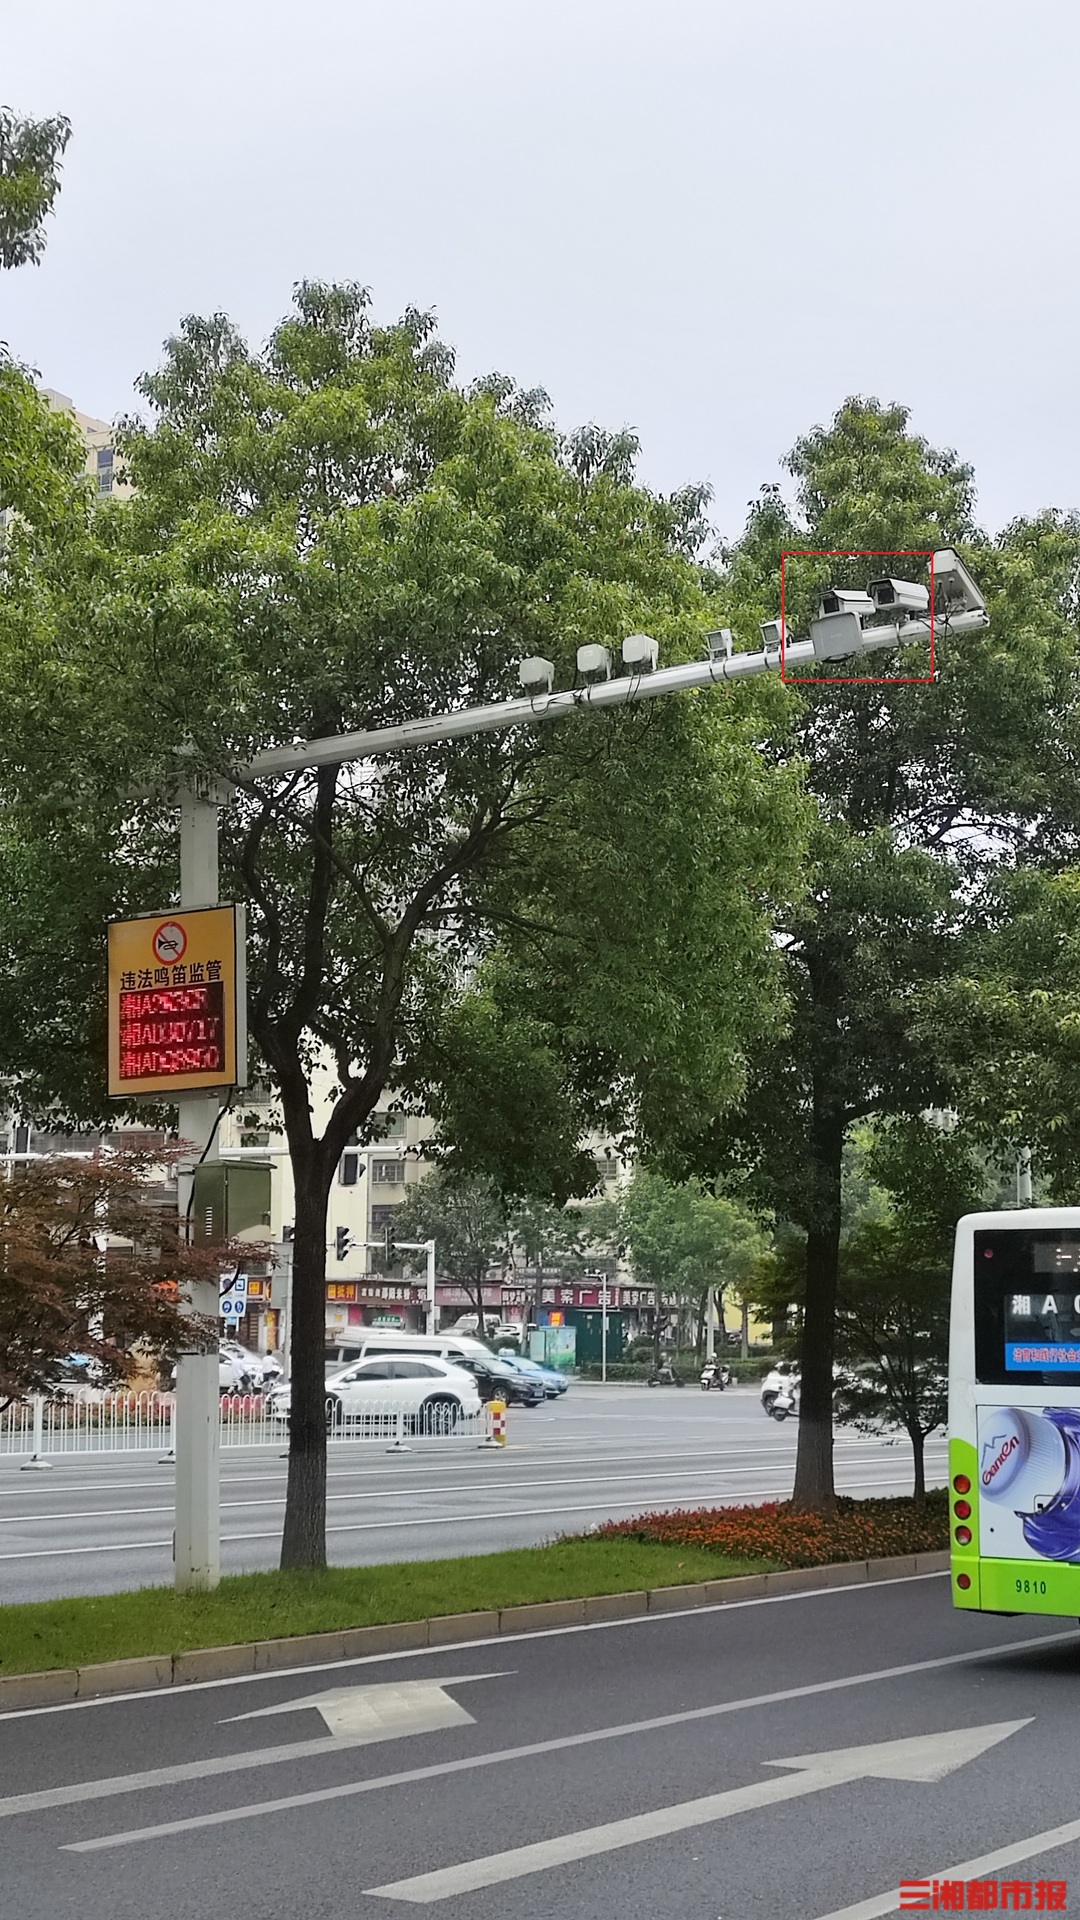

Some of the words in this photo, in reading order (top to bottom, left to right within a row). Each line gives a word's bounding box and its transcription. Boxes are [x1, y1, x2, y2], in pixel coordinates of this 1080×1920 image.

[120, 960, 222, 991] 违法鸣笛监管
[1015, 1579, 1047, 1595] 9810
